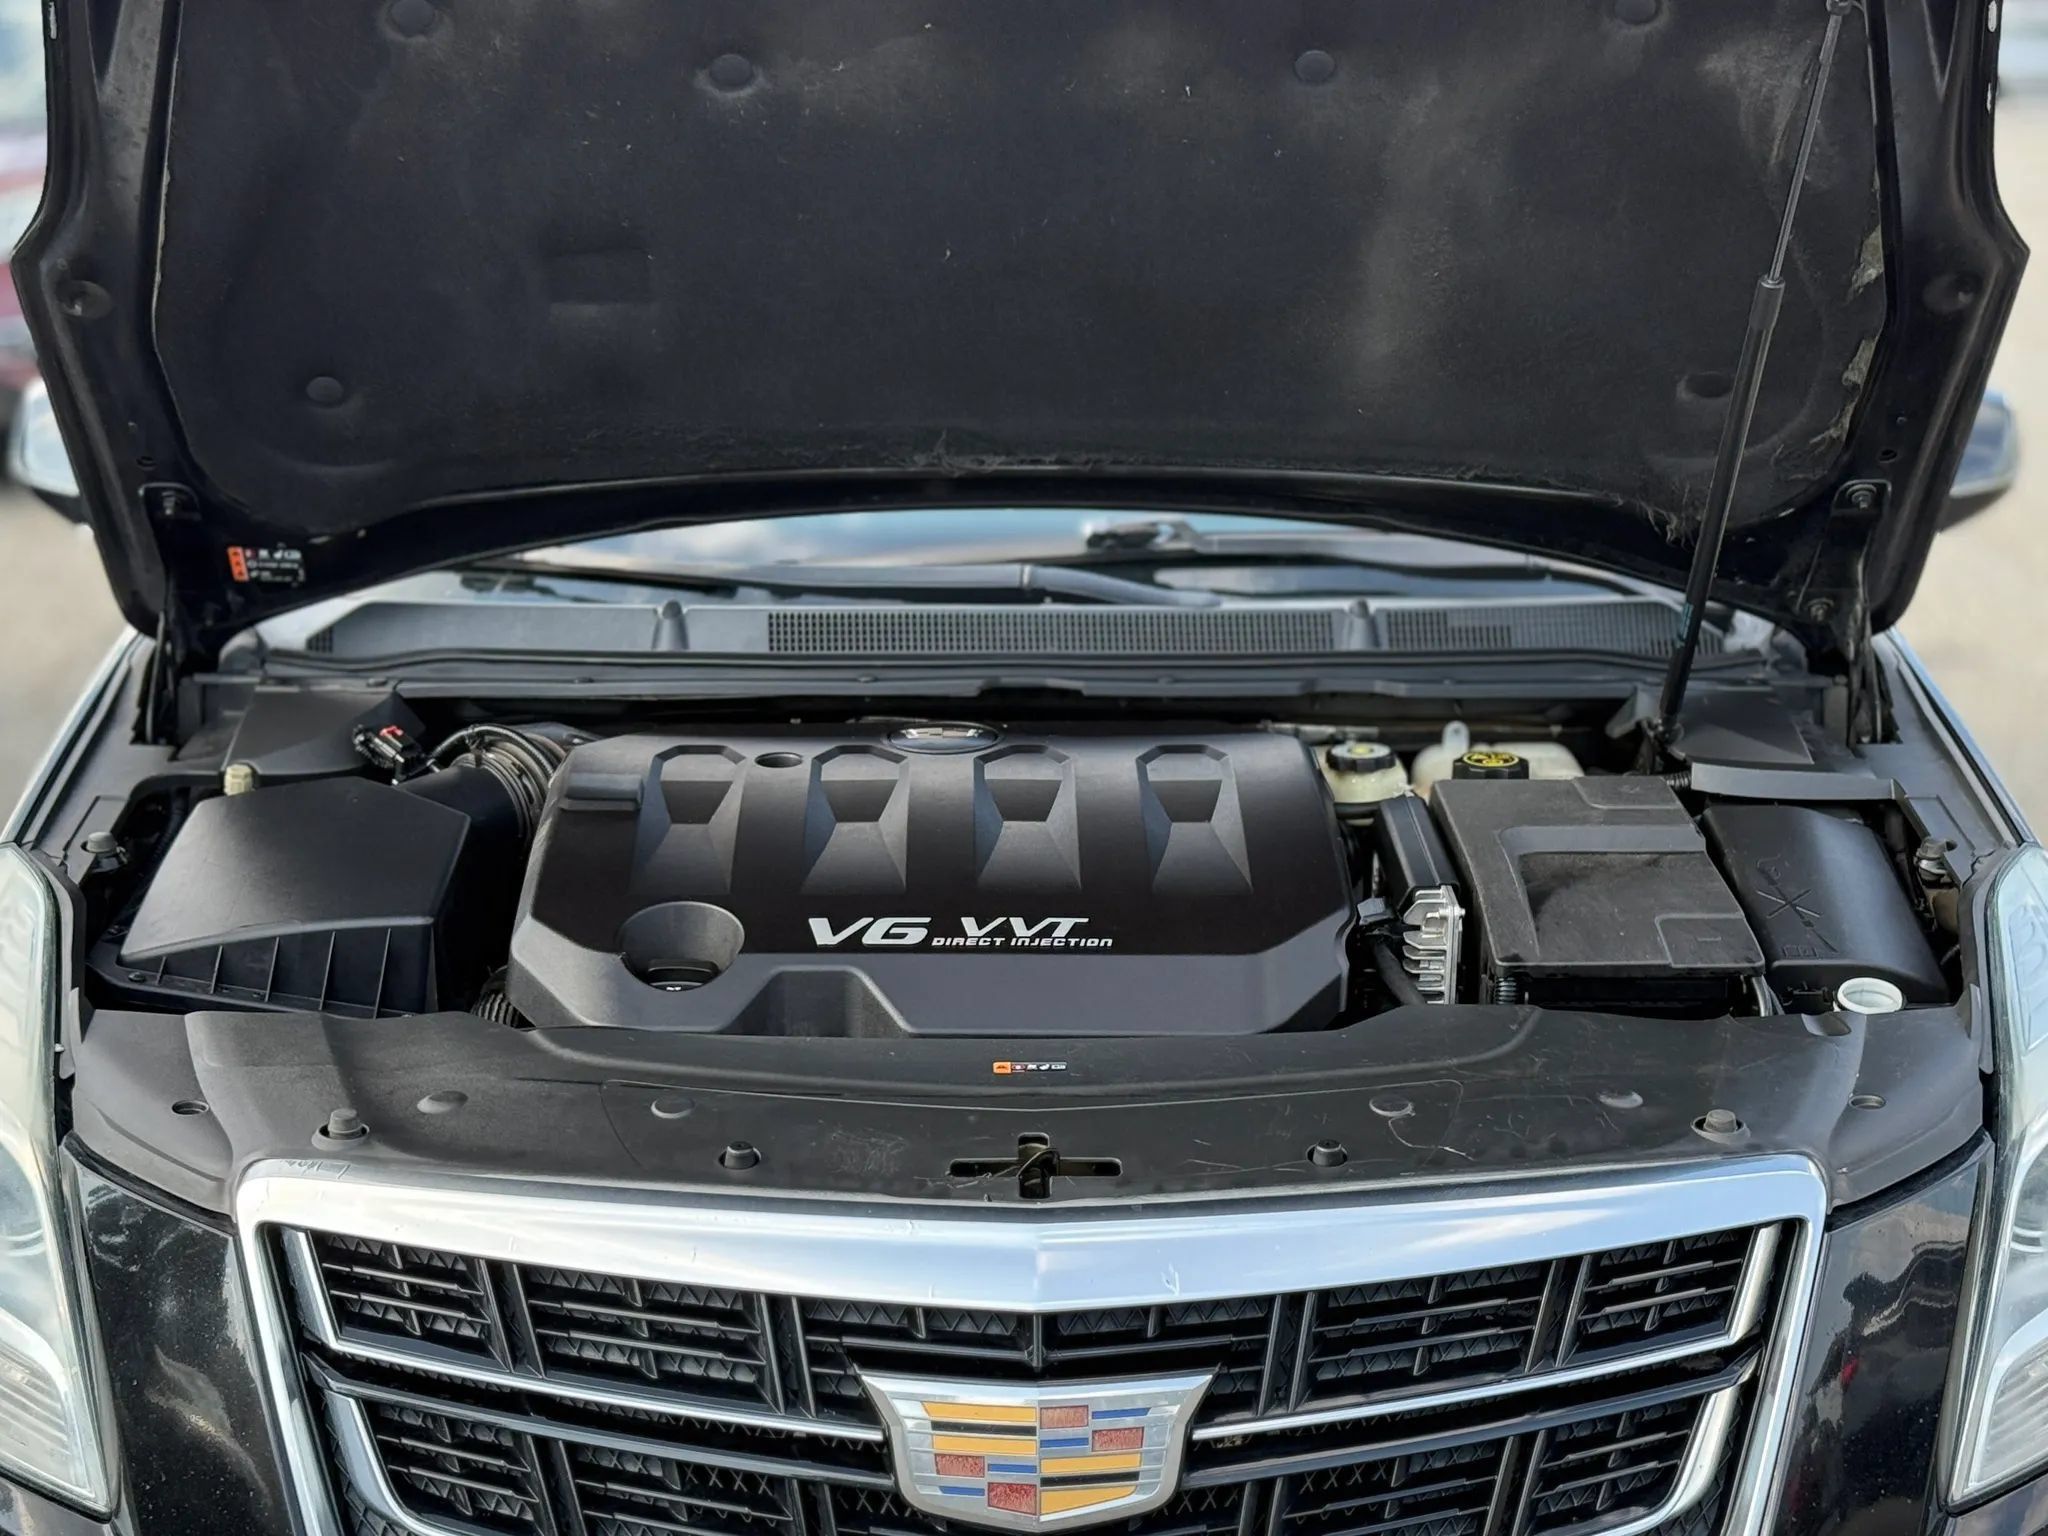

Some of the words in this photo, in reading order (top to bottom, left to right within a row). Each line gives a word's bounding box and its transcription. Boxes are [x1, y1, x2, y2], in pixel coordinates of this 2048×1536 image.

[808, 917, 932, 945] V6
[960, 917, 1089, 937] VVT
[931, 937, 1005, 947] DIRECT
[1010, 937, 1113, 948] INJECTION
